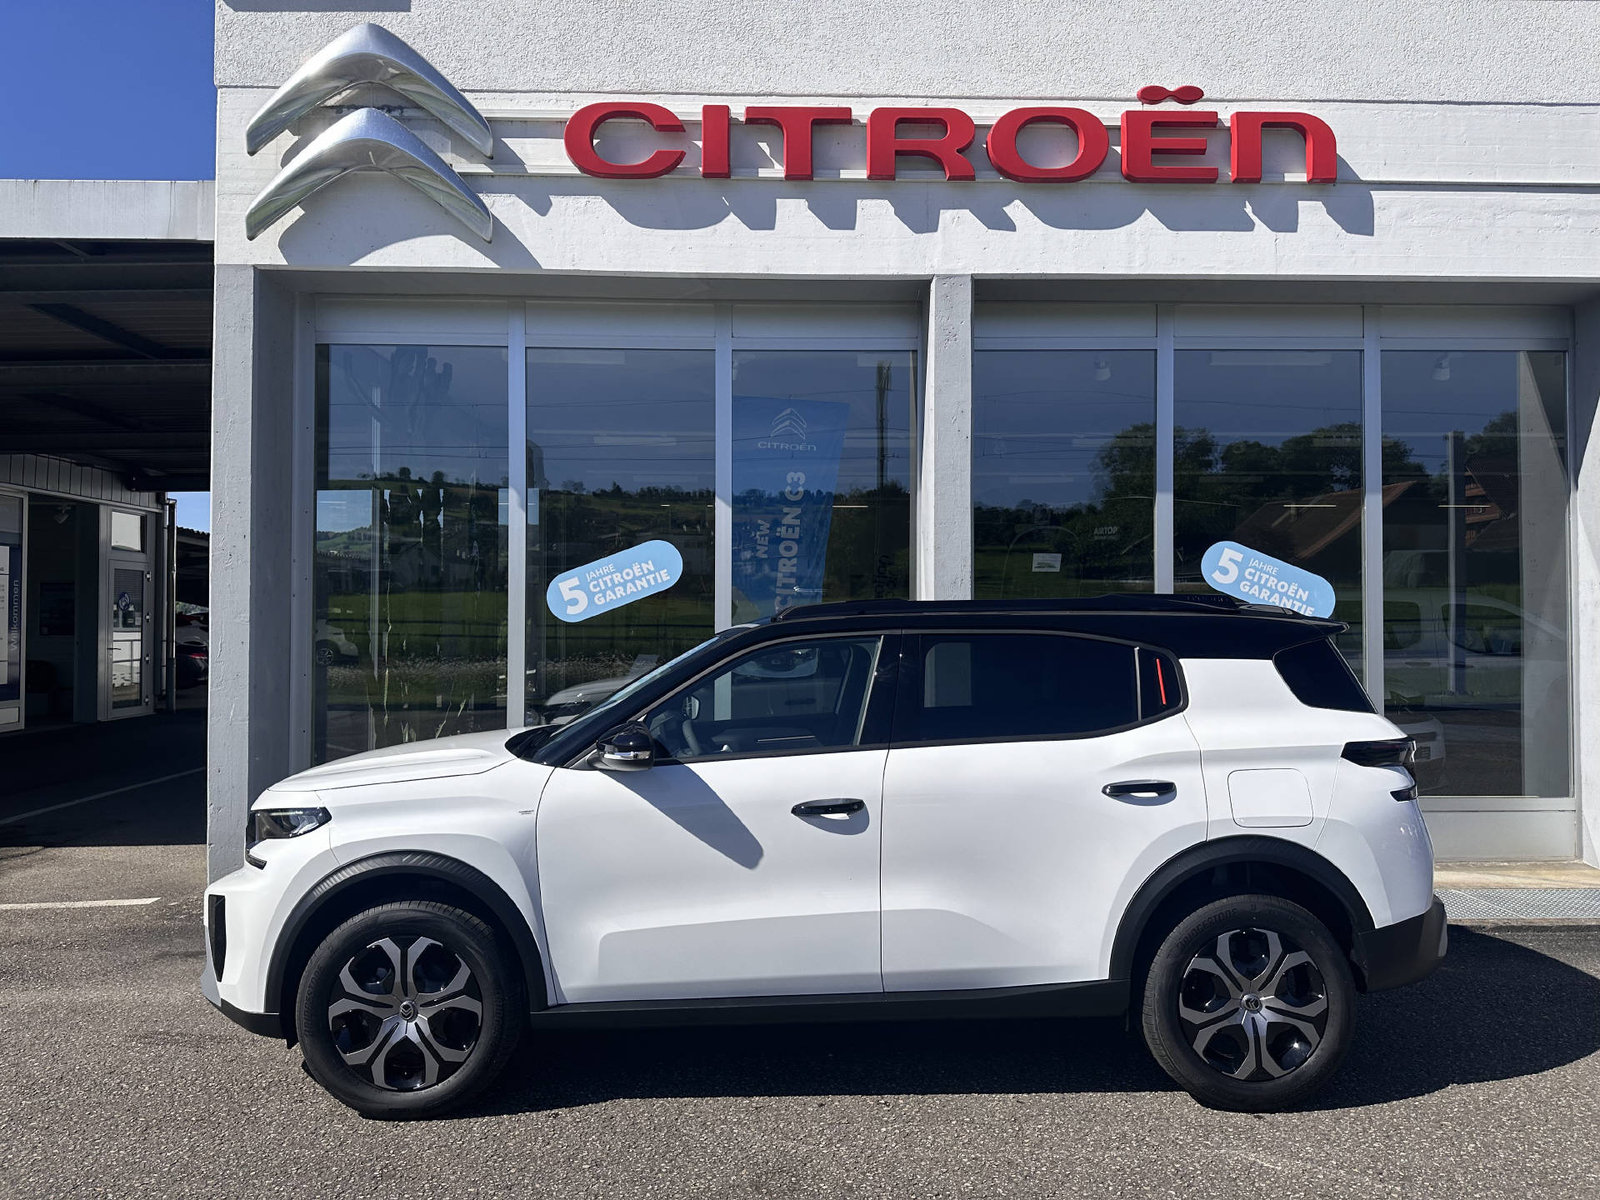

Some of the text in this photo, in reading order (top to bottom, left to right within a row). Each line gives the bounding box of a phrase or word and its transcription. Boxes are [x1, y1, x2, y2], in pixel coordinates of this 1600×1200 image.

[564, 86, 1337, 184] CITROËN
[785, 471, 806, 501] C3
[756, 520, 770, 559] NEW
[585, 563, 616, 582] JAHRE
[589, 560, 655, 593] CITROËN
[1211, 547, 1244, 584] 5
[1248, 558, 1280, 576] JAHRE
[558, 576, 589, 615] 5
[594, 569, 671, 606] GARANTIE
[1240, 581, 1315, 616] GARANTIE
[1244, 568, 1309, 602] CITROËN
